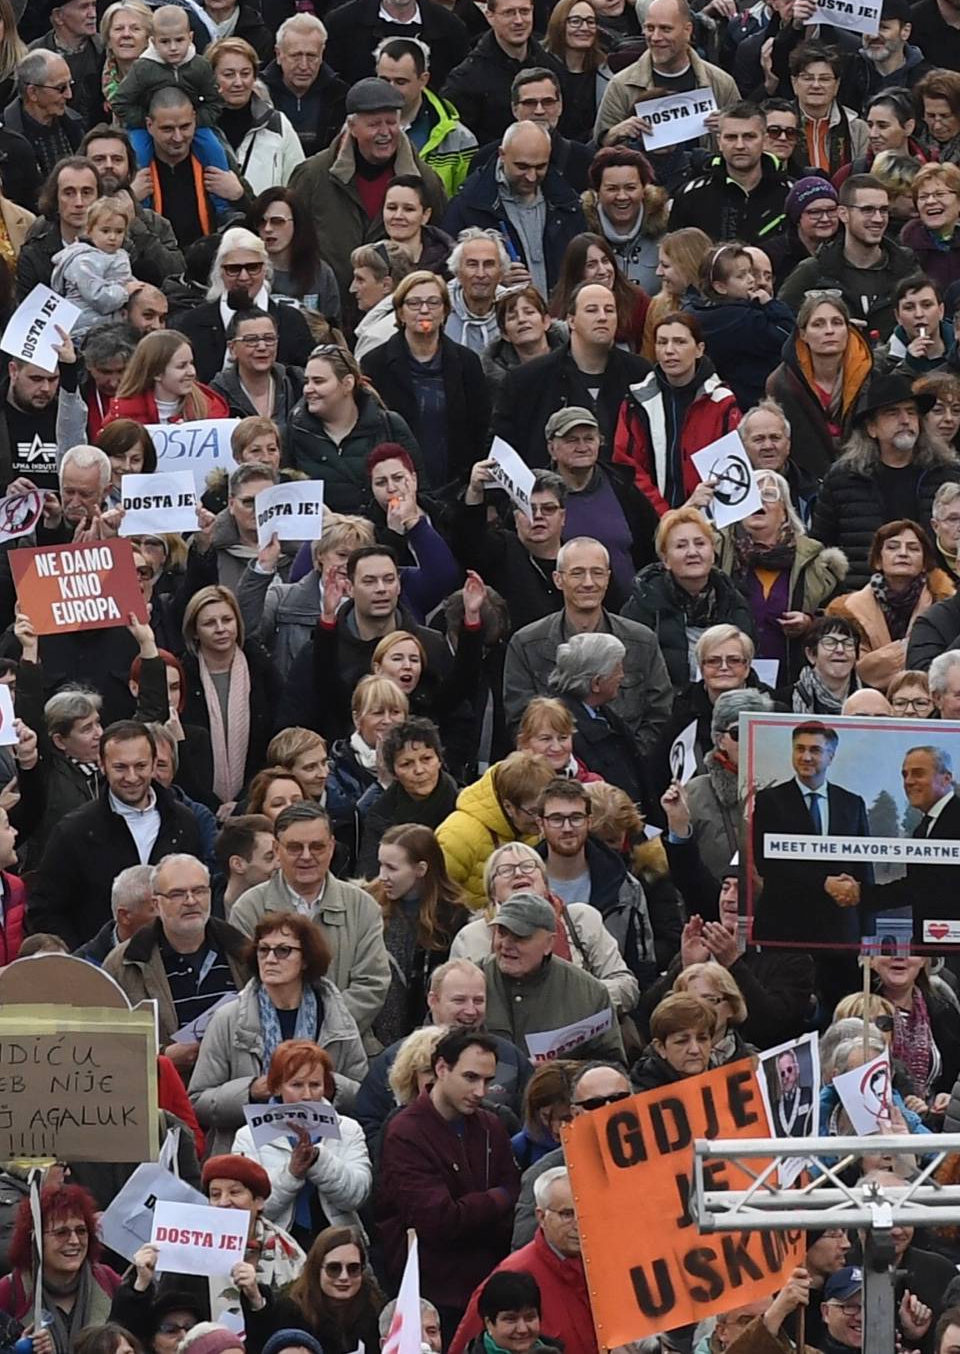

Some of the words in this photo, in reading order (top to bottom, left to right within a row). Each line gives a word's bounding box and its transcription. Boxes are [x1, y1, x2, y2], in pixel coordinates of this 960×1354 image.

[857, 4, 879, 20] JE!
[642, 106, 690, 125] DOSTA
[693, 99, 713, 115] JE!
[20, 317, 46, 359] DOSTA
[41, 294, 60, 317] JE!
[124, 495, 173, 510] DOSTA
[177, 493, 198, 507] JE!
[258, 503, 293, 527] DOSTA
[297, 502, 320, 515] JE!
[34, 552, 58, 577] NE
[60, 546, 114, 574] DAMO
[57, 572, 102, 599] KINO
[52, 596, 122, 625] EUROPA
[769, 840, 807, 853] MEET
[811, 841, 838, 854] THE
[841, 842, 902, 856] MAYOR'S
[29, 1105, 138, 1134] AGALUK
[251, 1112, 308, 1127] DOSTA
[313, 1113, 335, 1126] JE!
[605, 1070, 759, 1169] GDJE
[155, 1226, 213, 1248] DOSTA
[218, 1234, 243, 1251] JE!
